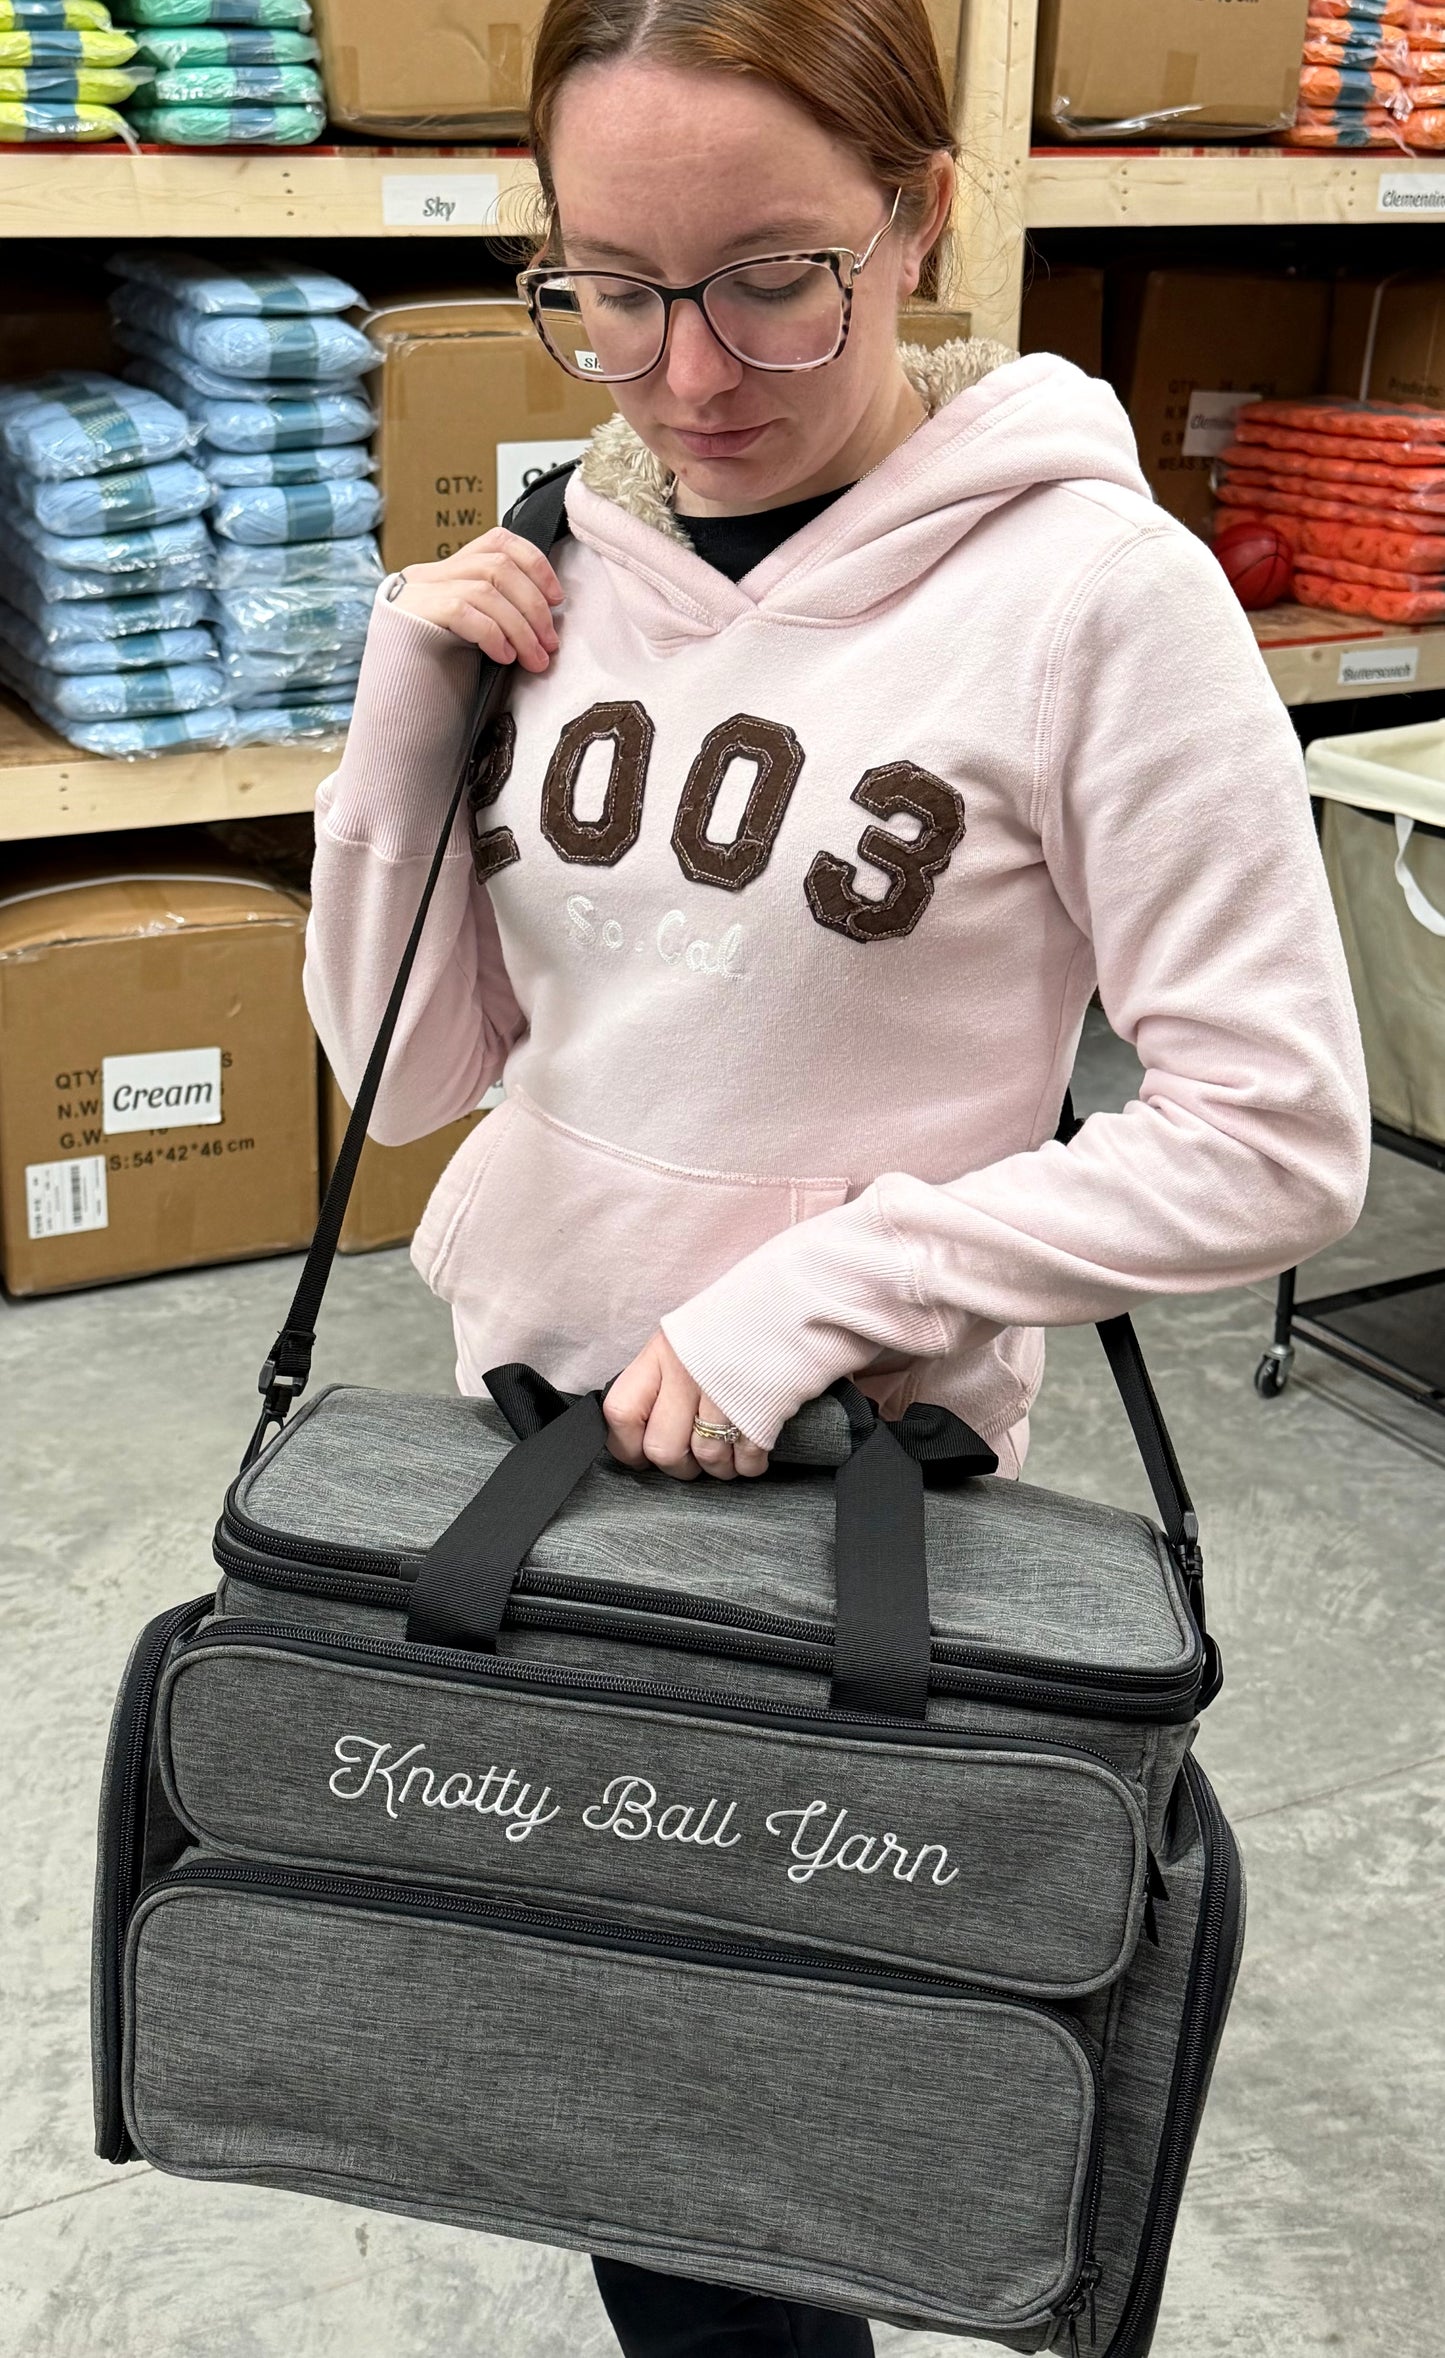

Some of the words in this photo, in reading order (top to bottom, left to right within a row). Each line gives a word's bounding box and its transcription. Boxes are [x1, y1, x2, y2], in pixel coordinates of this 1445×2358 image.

[422, 196, 456, 222] Sky
[435, 475, 483, 495] QTY:
[435, 508, 483, 528] N.W:
[112, 1083, 213, 1113] Cream
[227, 1138, 255, 1152] cm
[329, 1735, 559, 1843] Knotty
[582, 1775, 741, 1848] Ball
[766, 1799, 960, 1886] Yarn
